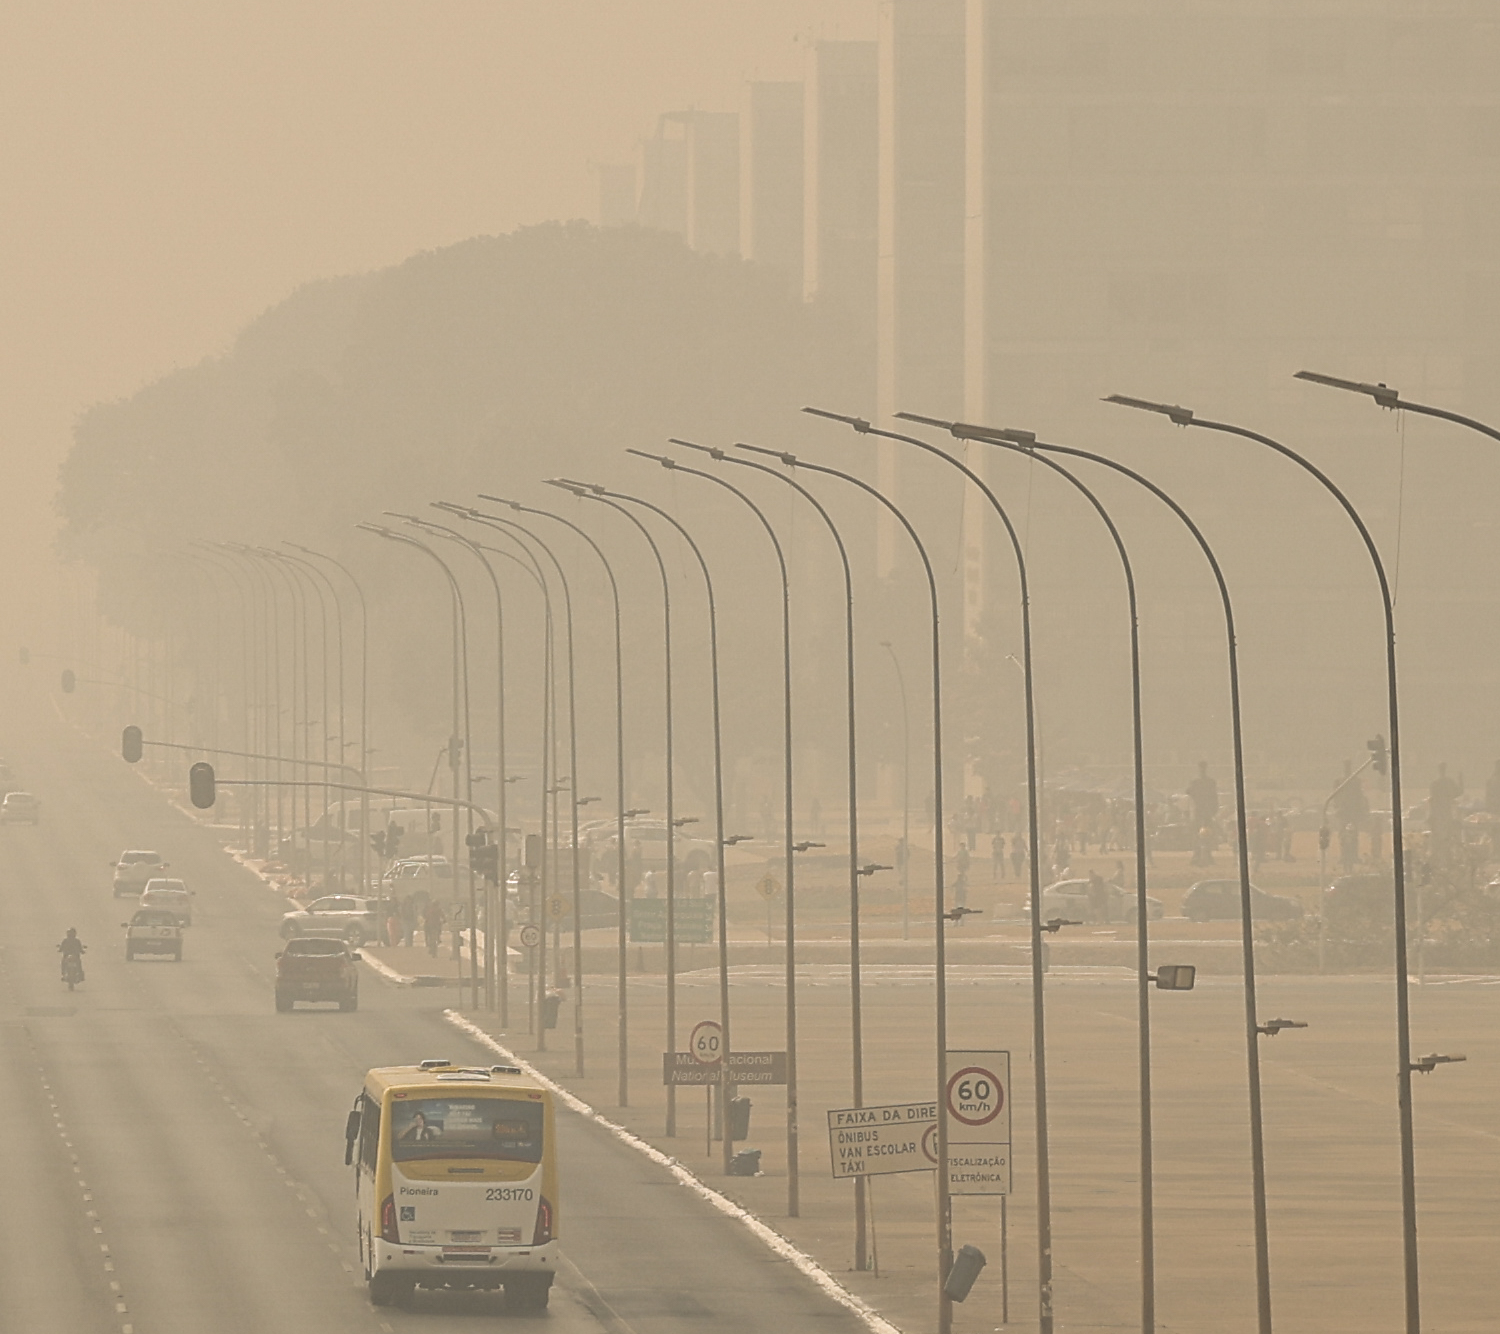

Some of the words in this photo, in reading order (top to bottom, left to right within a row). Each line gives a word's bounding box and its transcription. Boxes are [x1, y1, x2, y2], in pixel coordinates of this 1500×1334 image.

[697, 1035, 719, 1051] 60
[729, 1054, 773, 1065] acional
[958, 1080, 990, 1100] 60
[959, 1101, 991, 1112] km/h
[837, 1112, 876, 1125] FAIXA
[883, 1110, 901, 1121] DA
[907, 1106, 937, 1119] DIRE
[838, 1130, 879, 1144] ÔNIBUS
[839, 1147, 863, 1159] VAN
[867, 1142, 916, 1156] ESCOLAR
[840, 1159, 865, 1173] TÁXI
[951, 1172, 1001, 1183] ELETRÔNICA
[399, 1186, 439, 1196] Pioneira
[485, 1188, 534, 1201] 233170
